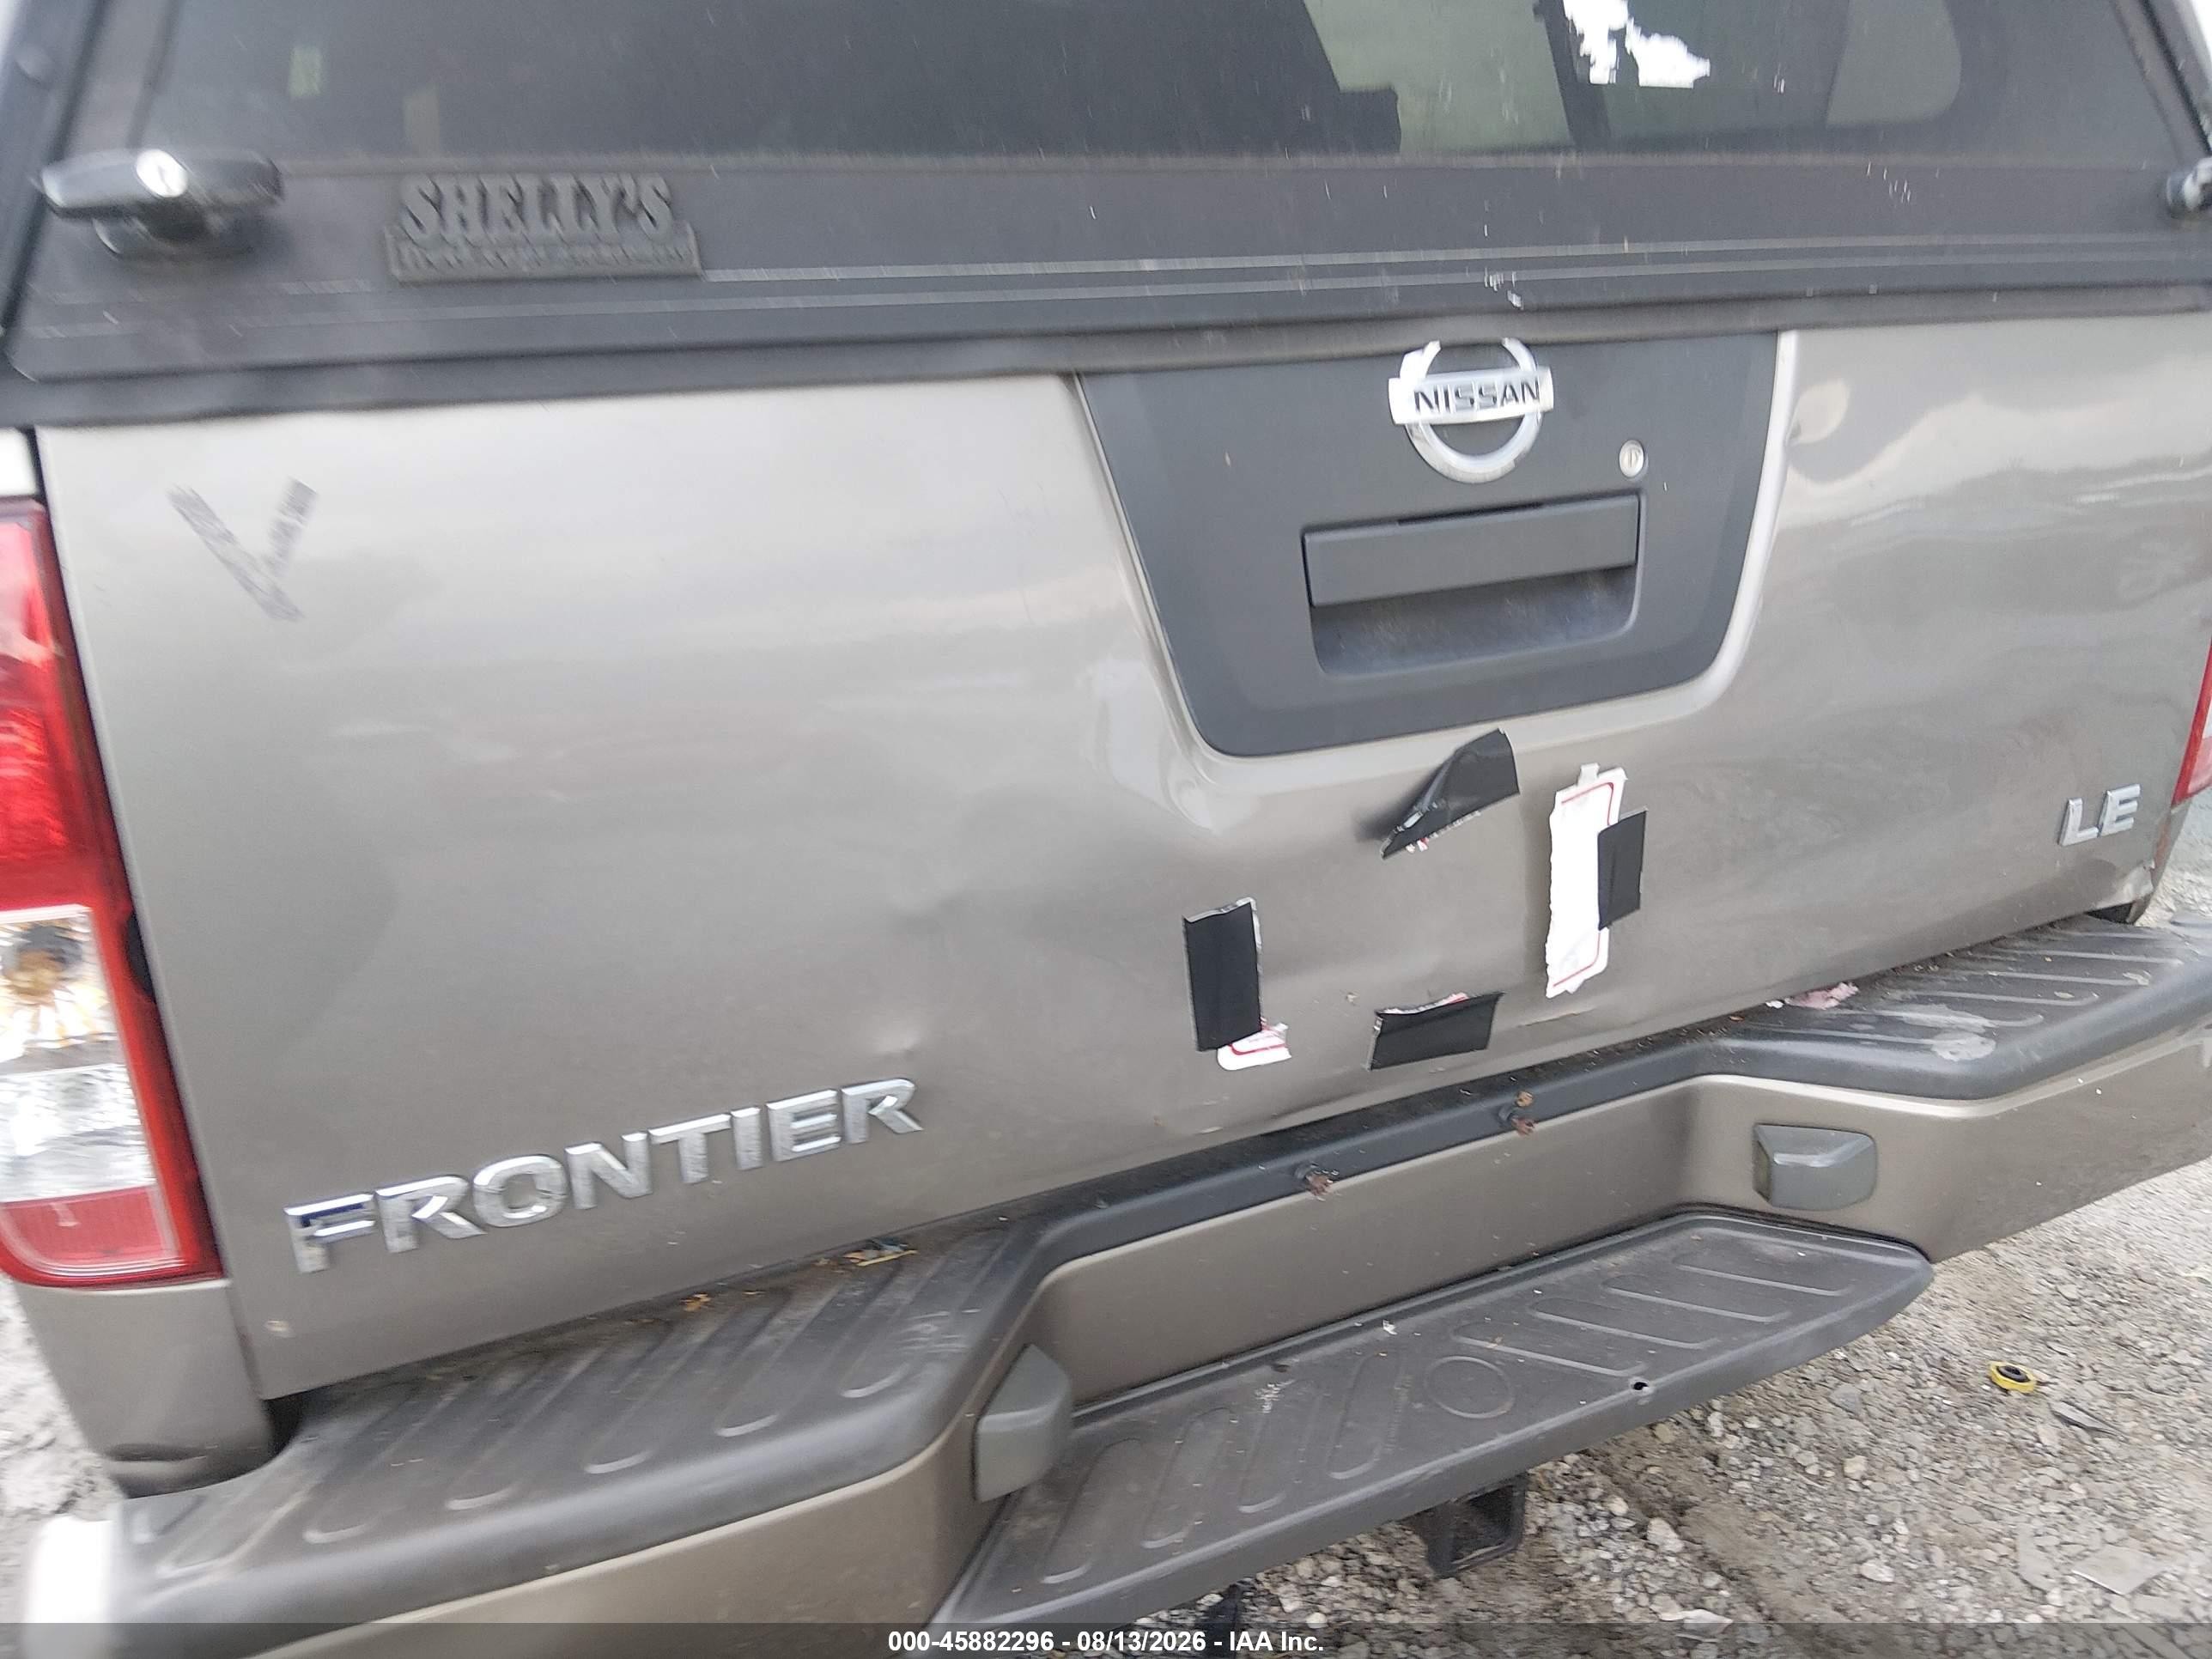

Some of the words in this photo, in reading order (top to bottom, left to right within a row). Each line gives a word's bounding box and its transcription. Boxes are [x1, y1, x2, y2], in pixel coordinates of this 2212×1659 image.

[398, 173, 673, 248] SHELLY'S
[1413, 378, 1540, 414] NISSAN
[2057, 783, 2141, 847] LE
[283, 1078, 923, 1273] FRONTIER
